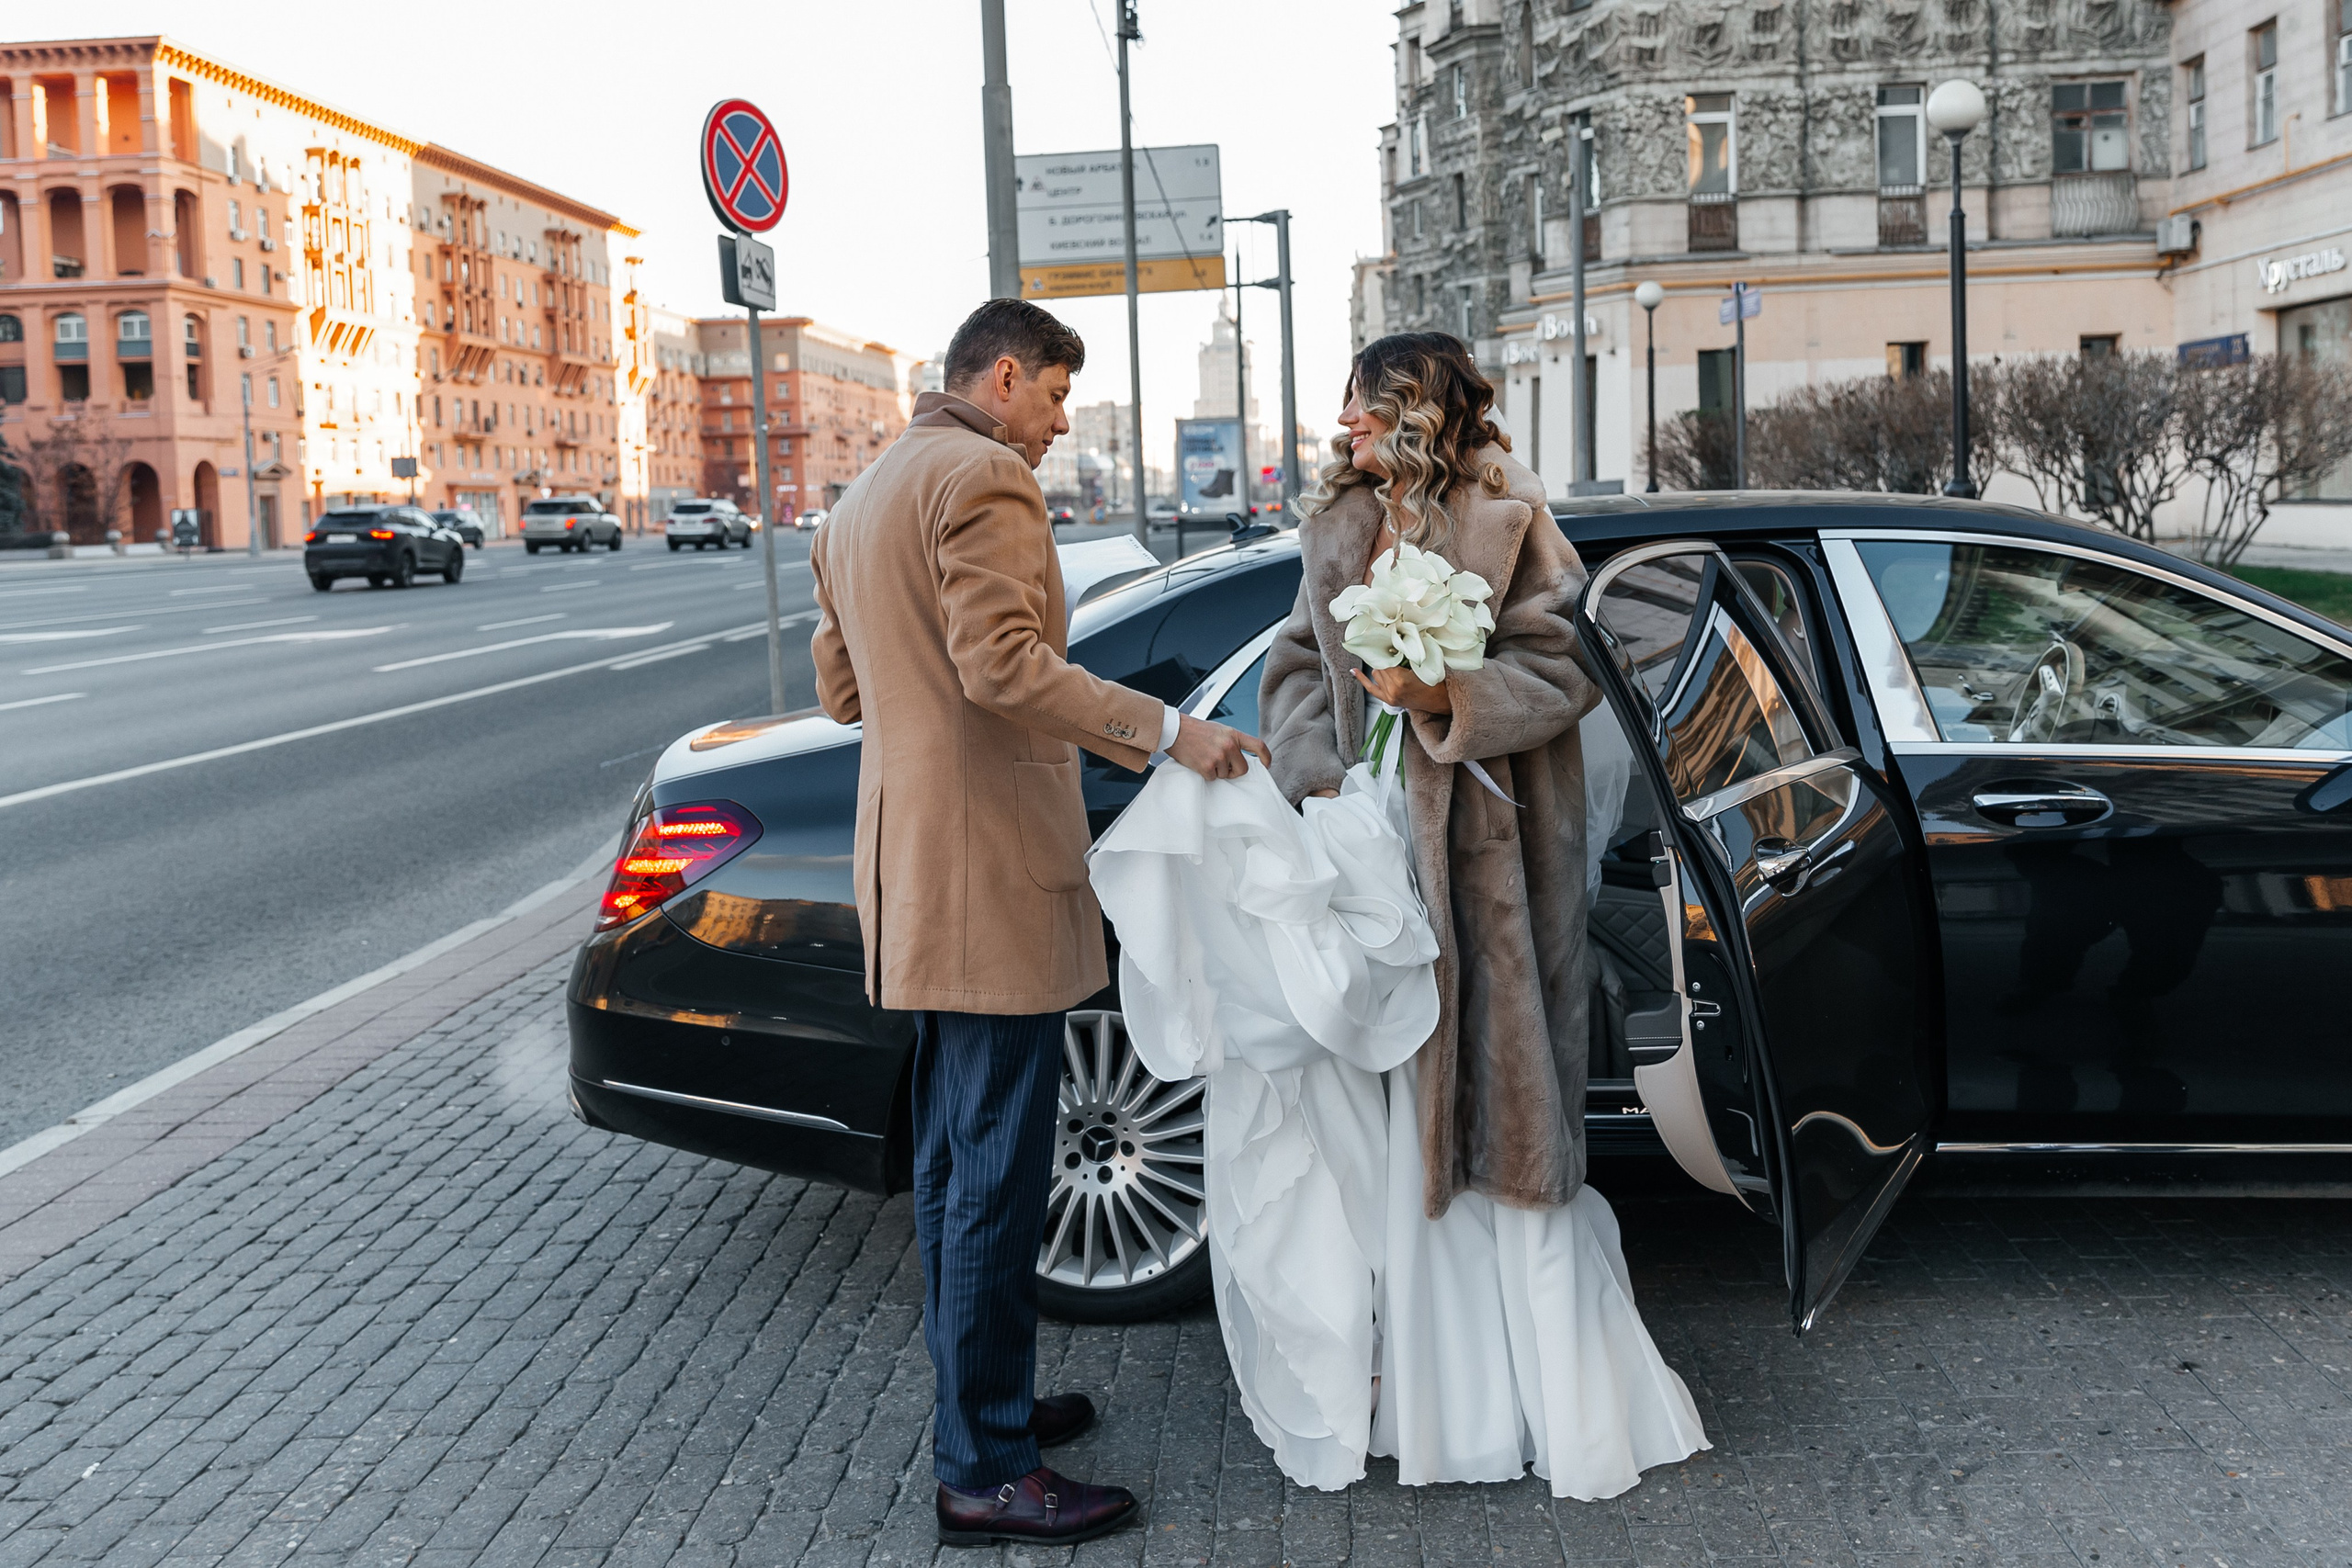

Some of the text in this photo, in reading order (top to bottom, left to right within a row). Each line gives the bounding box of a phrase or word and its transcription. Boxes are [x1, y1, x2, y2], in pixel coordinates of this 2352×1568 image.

[1108, 235, 1152, 247] ВОАЛ
[2256, 247, 2346, 295] Хрусталь
[1509, 341, 1540, 365] Boc
